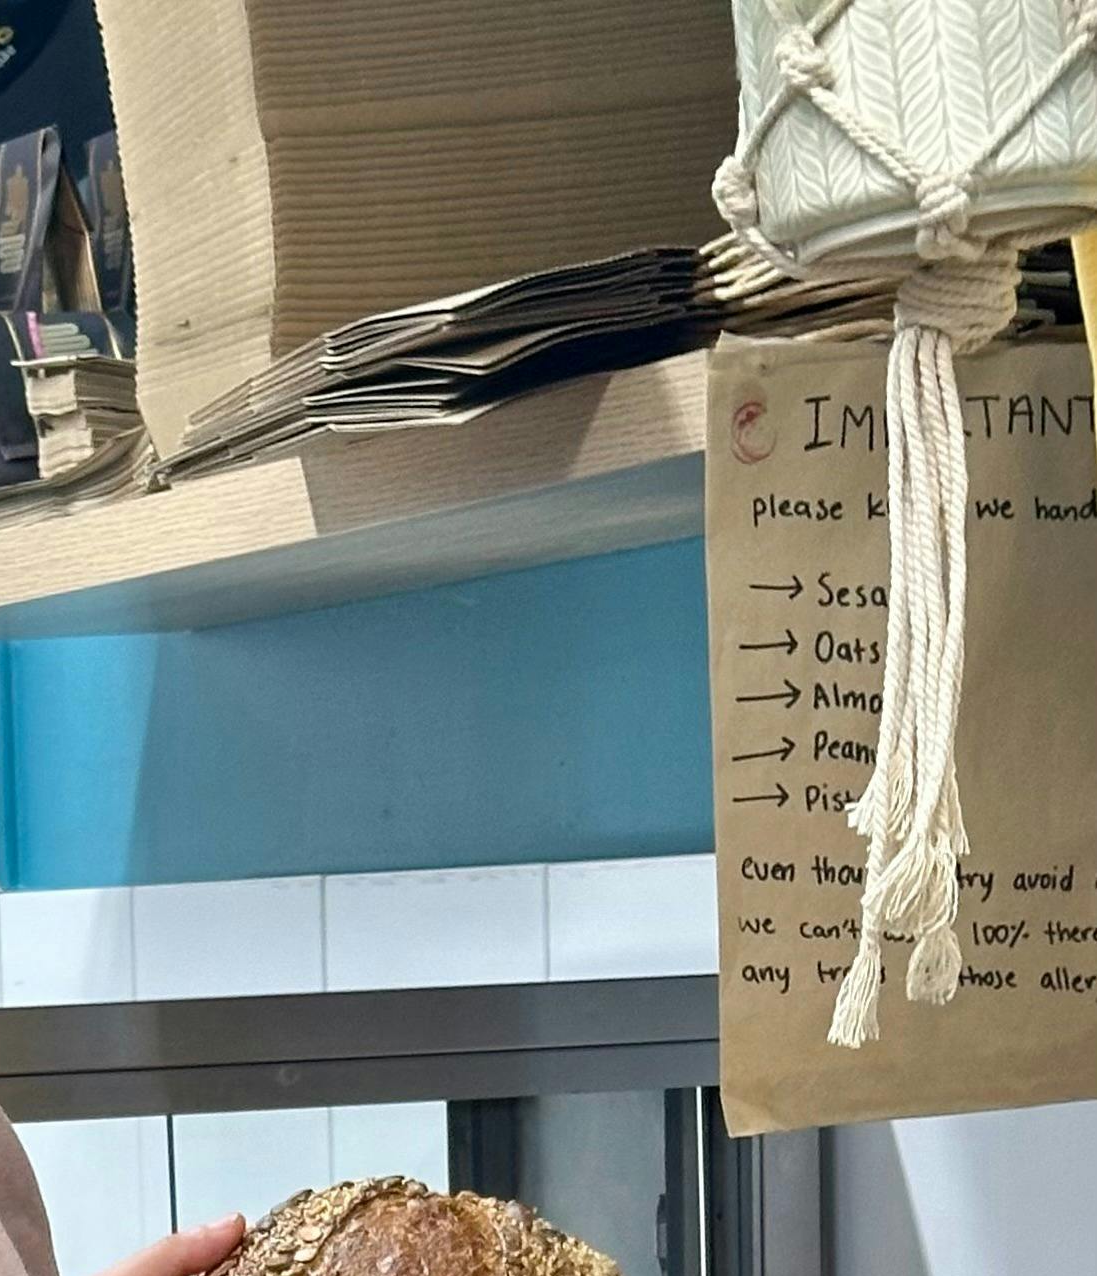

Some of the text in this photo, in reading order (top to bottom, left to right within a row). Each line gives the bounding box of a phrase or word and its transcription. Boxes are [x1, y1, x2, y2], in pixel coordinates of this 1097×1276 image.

[802, 393, 1096, 452] IMTANT
[752, 493, 844, 527] please
[975, 498, 1015, 522] we
[817, 571, 889, 608] Sesa
[814, 630, 881, 665] Oats
[812, 682, 883, 714] Almo
[805, 783, 860, 812] Pist
[741, 856, 795, 882] even
[1013, 864, 1075, 892] avoid
[738, 916, 776, 935] we
[799, 918, 861, 940] can't
[972, 920, 1030, 948] 100%
[742, 964, 790, 994] any
[958, 965, 1018, 989] those
